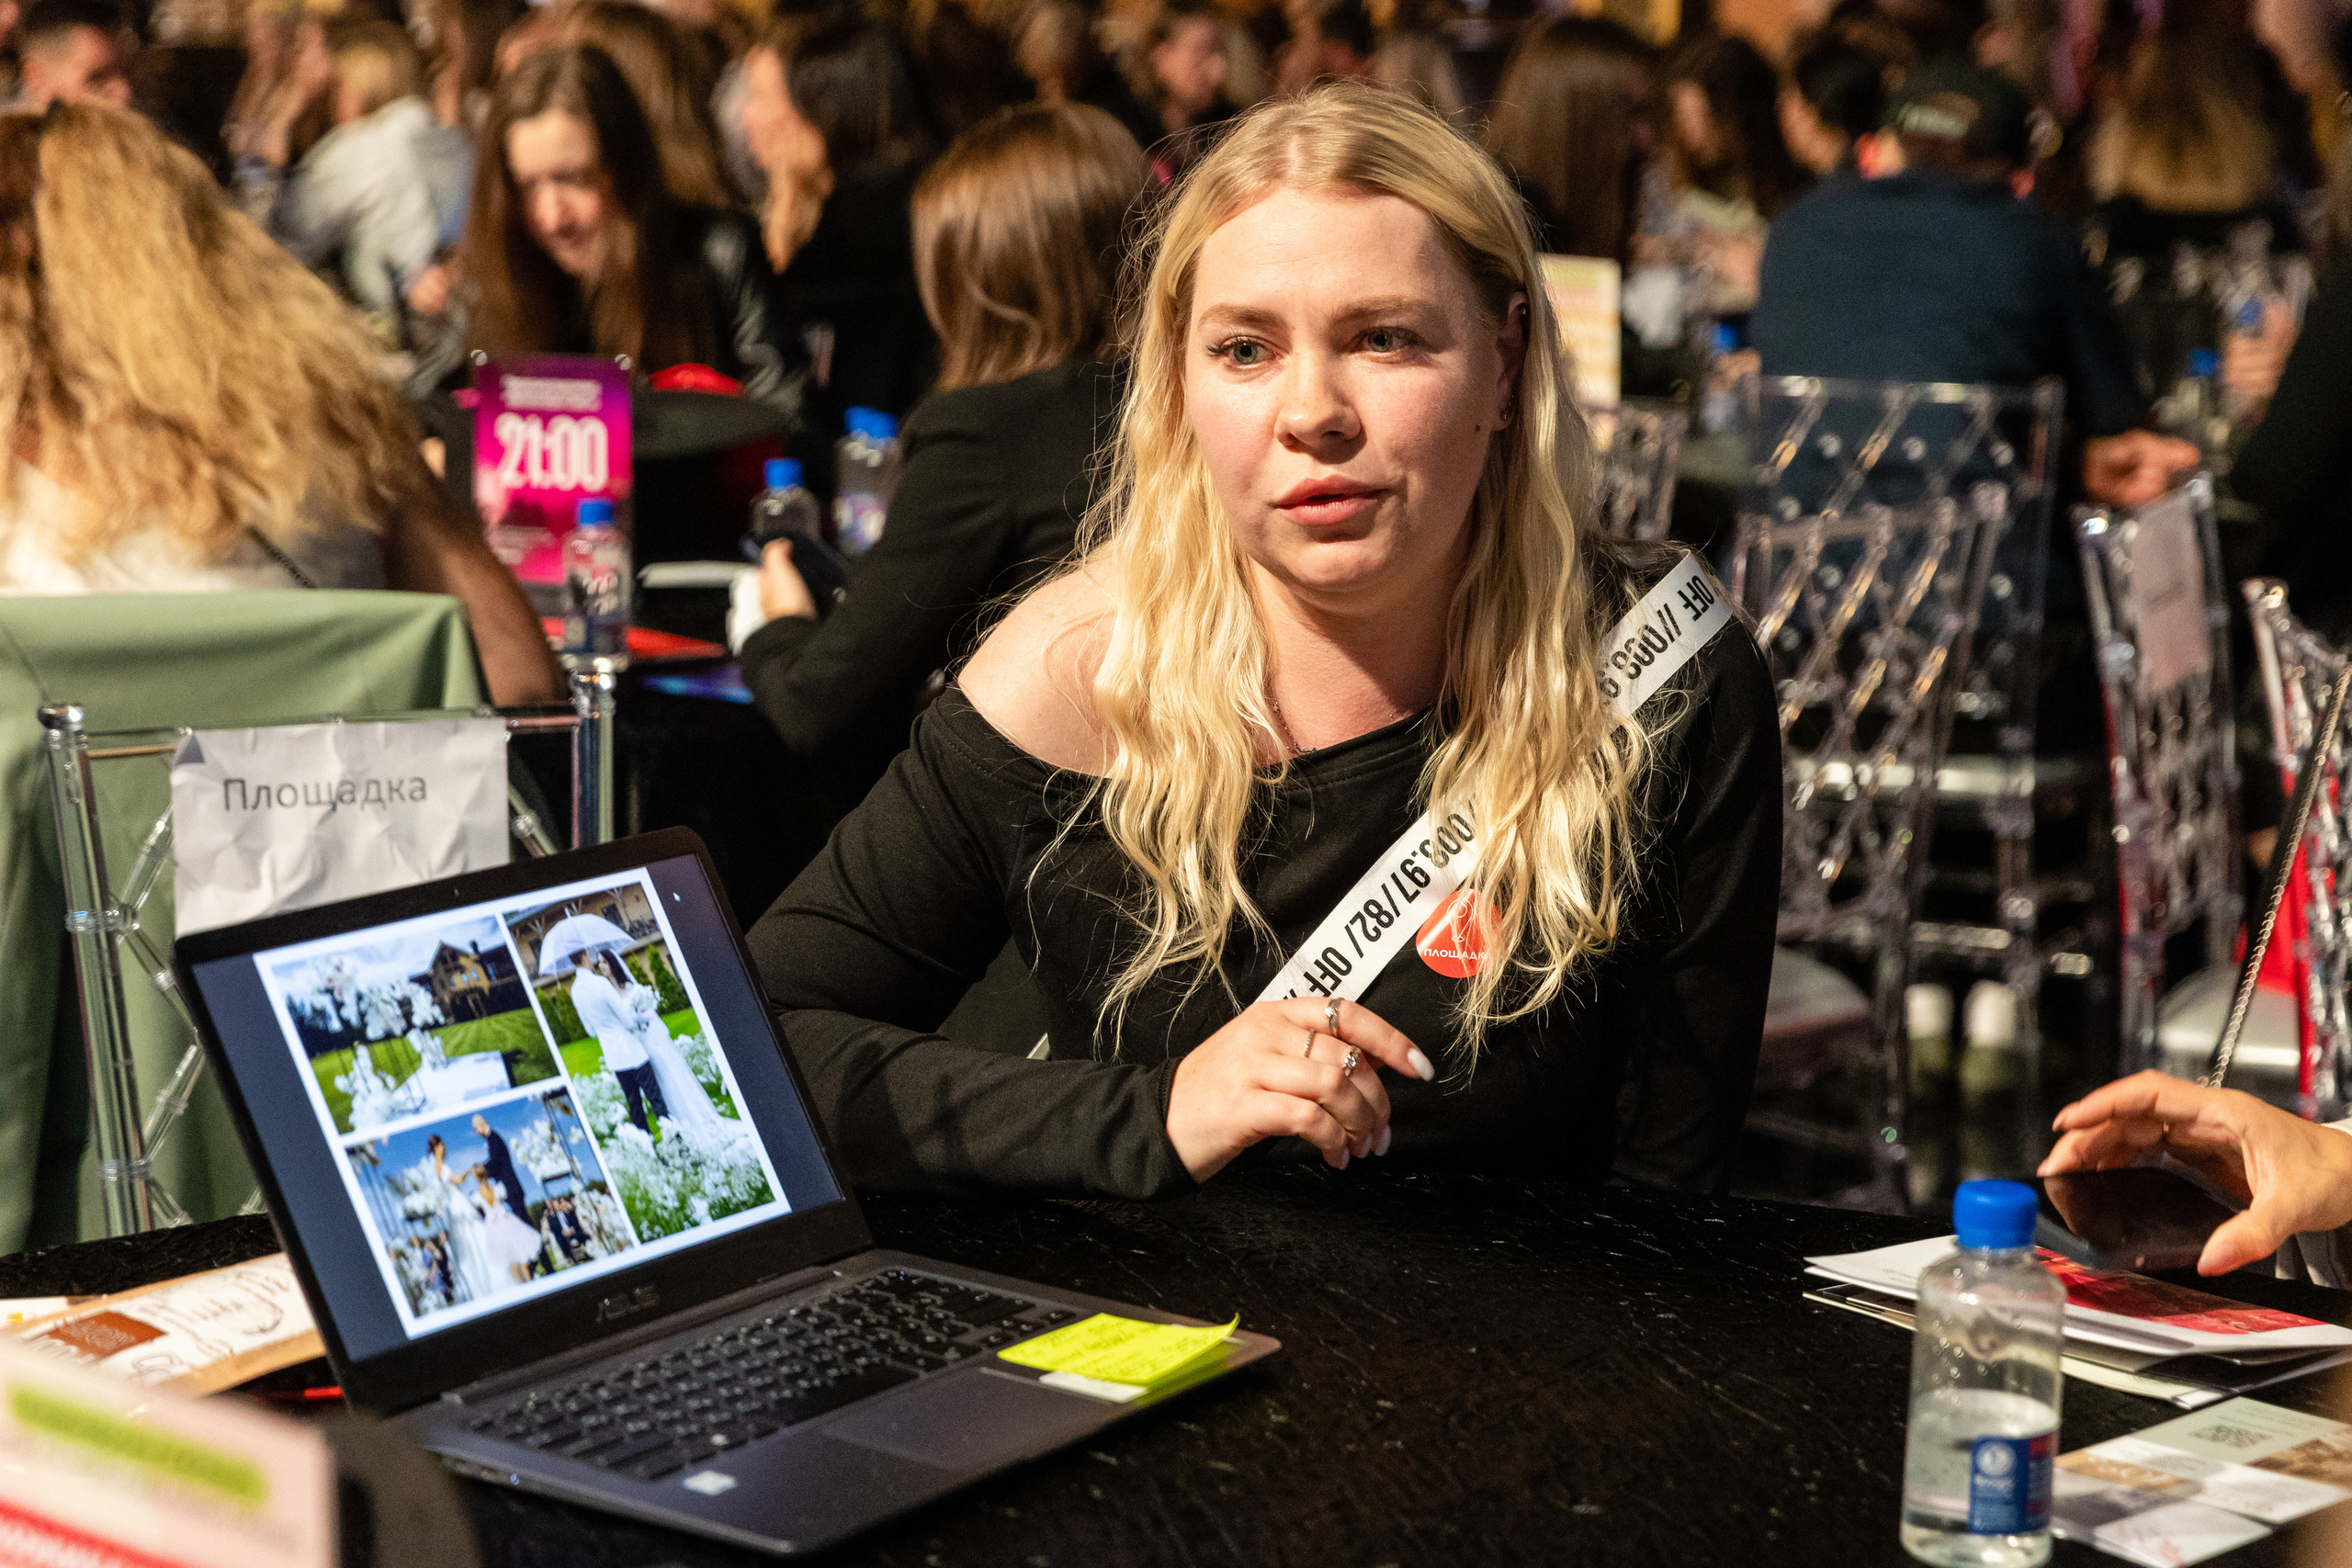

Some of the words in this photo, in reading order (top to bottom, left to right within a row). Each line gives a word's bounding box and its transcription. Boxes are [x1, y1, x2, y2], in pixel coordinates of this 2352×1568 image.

[494, 412, 608, 492] 21:00
[1678, 575, 1715, 622] OFF
[222, 775, 428, 812] Площадка
[1303, 946, 1353, 997] OFF
[1423, 948, 1490, 961] ПЛОЩАДК
